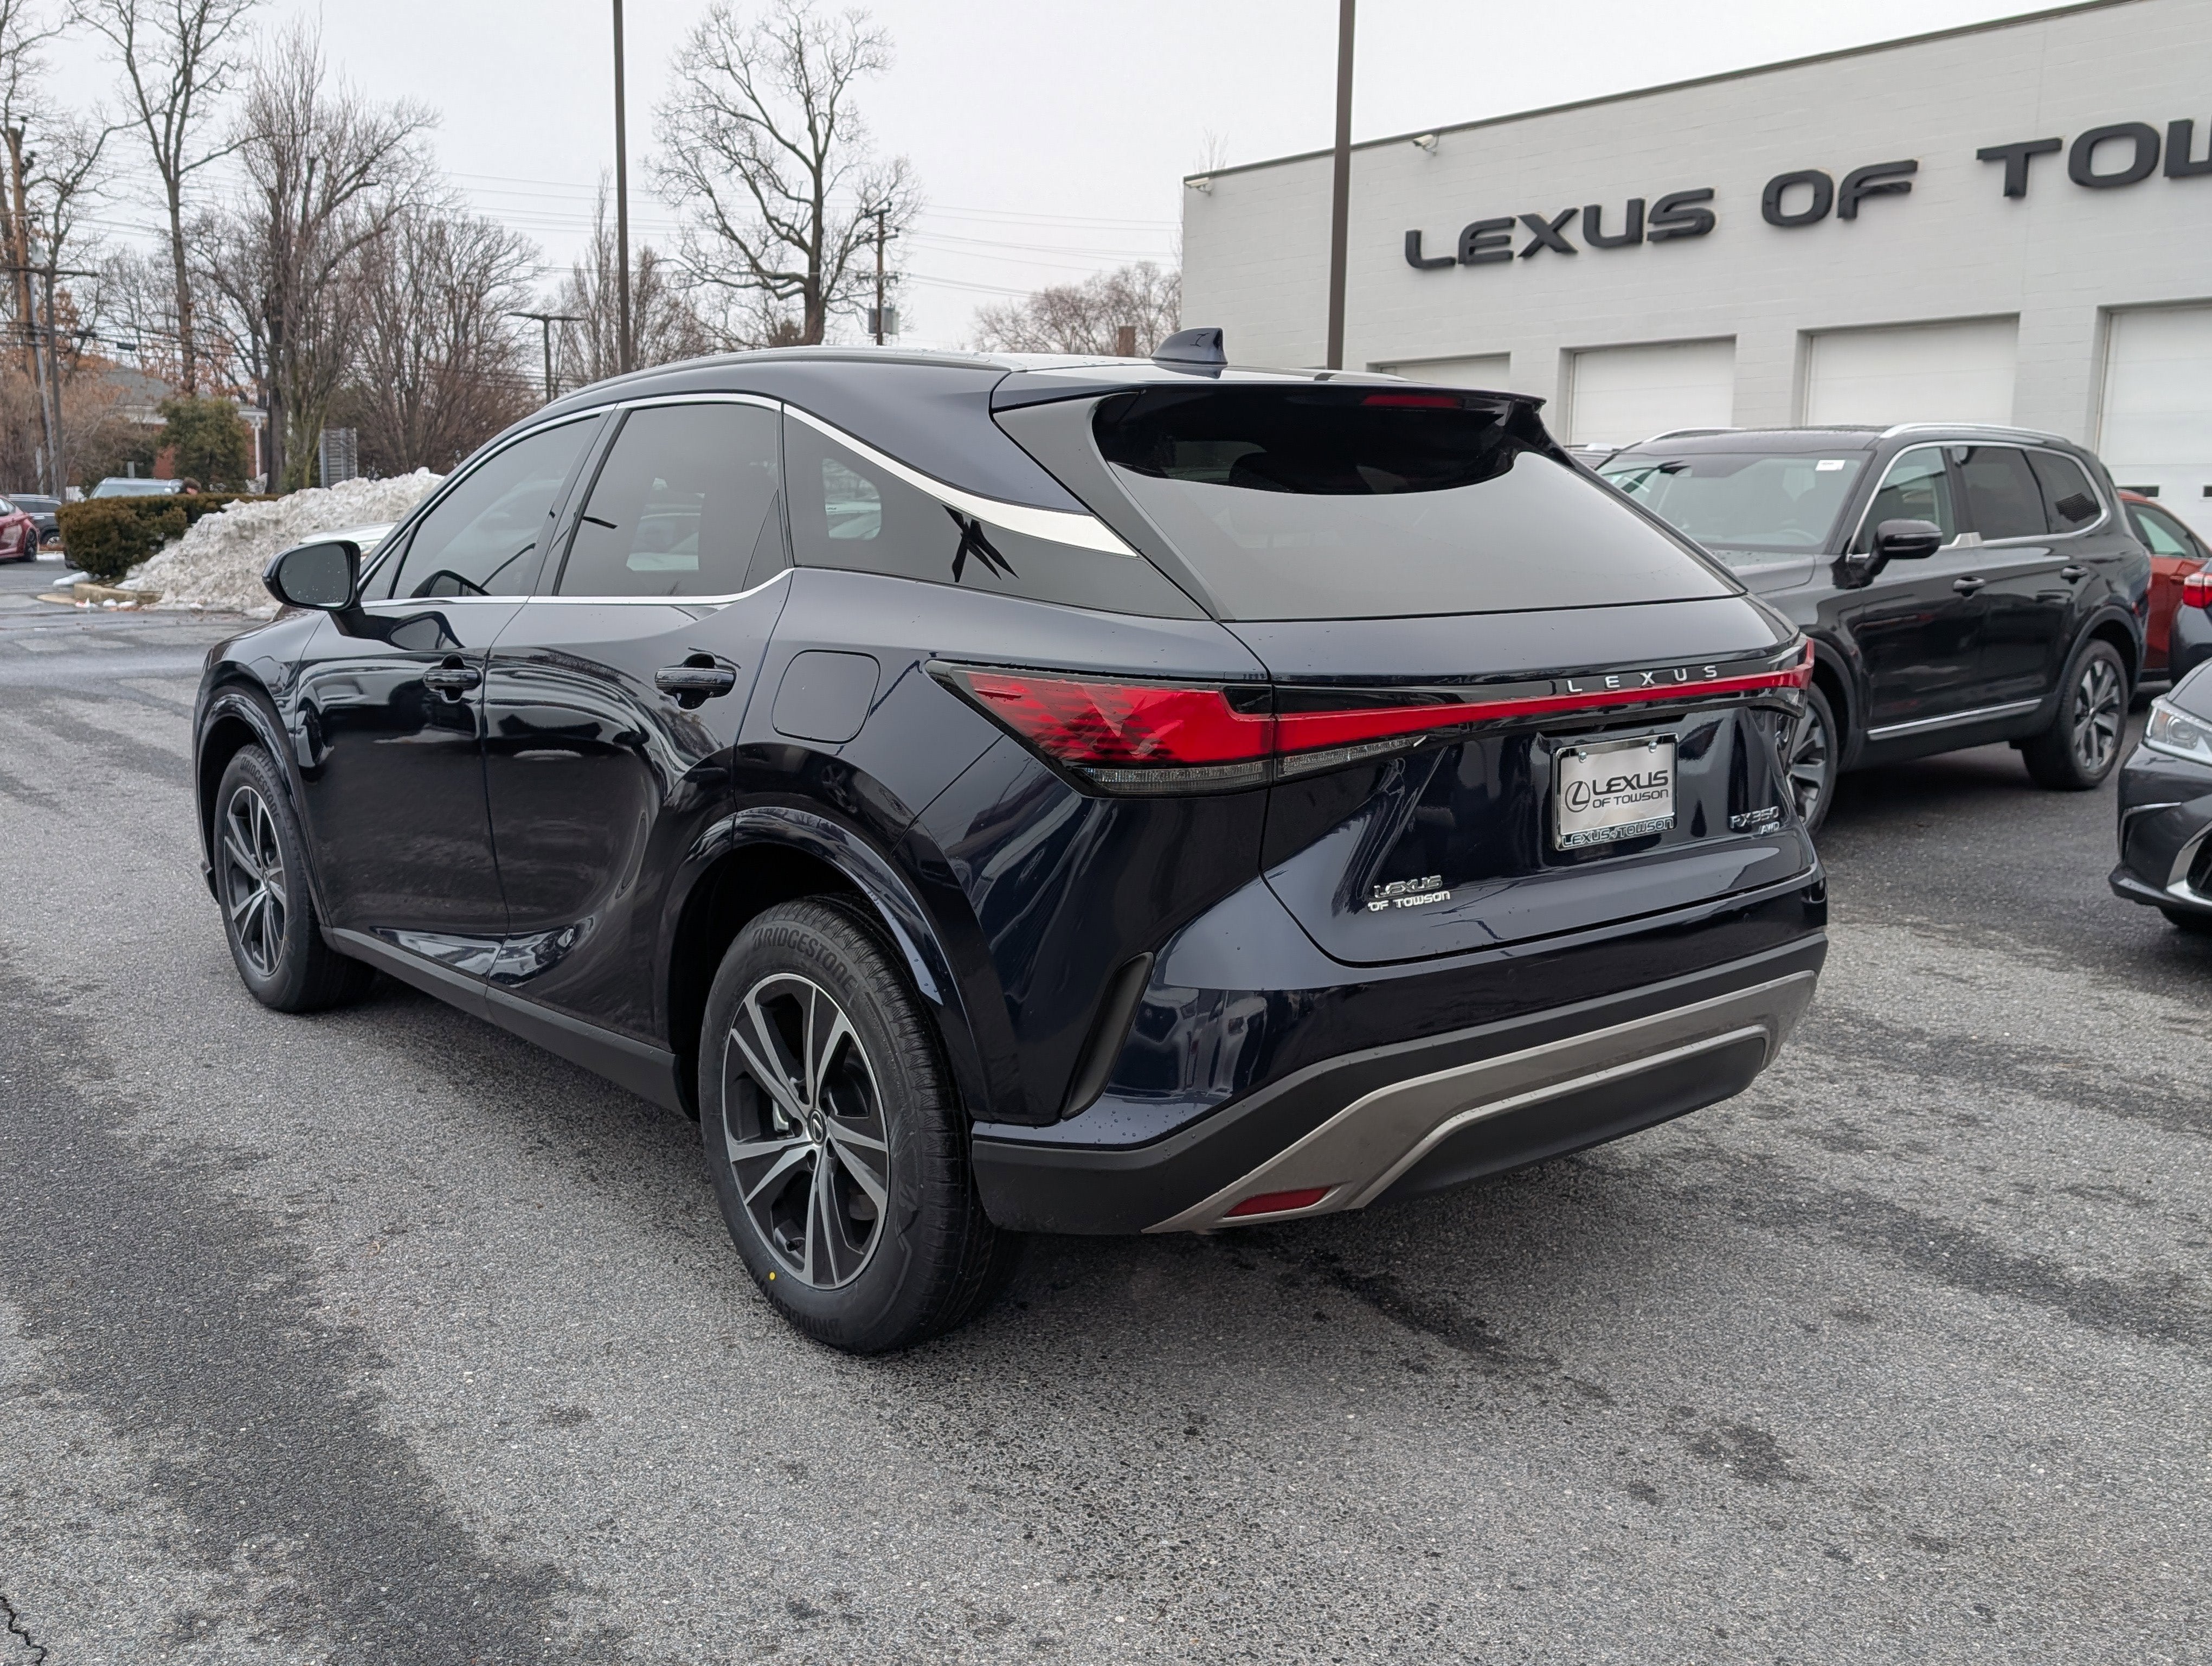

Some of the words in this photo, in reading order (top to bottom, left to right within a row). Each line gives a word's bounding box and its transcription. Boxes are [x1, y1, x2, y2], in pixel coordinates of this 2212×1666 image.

[1405, 187, 1716, 271] LEXUS
[1762, 159, 1919, 228] OF
[1567, 665, 1718, 693] LEXUS
[1592, 770, 1669, 796] LEXUS
[1592, 797, 1611, 809] OF
[1613, 789, 1669, 806] TOWSON
[1561, 828, 1610, 848] LEXUS
[1618, 817, 1674, 837] TOWSON
[1374, 875, 1443, 898] LEXUS
[1367, 900, 1389, 912] OF
[1393, 891, 1450, 908] TOWSON
[753, 926, 858, 996] BRIDGESTONE
